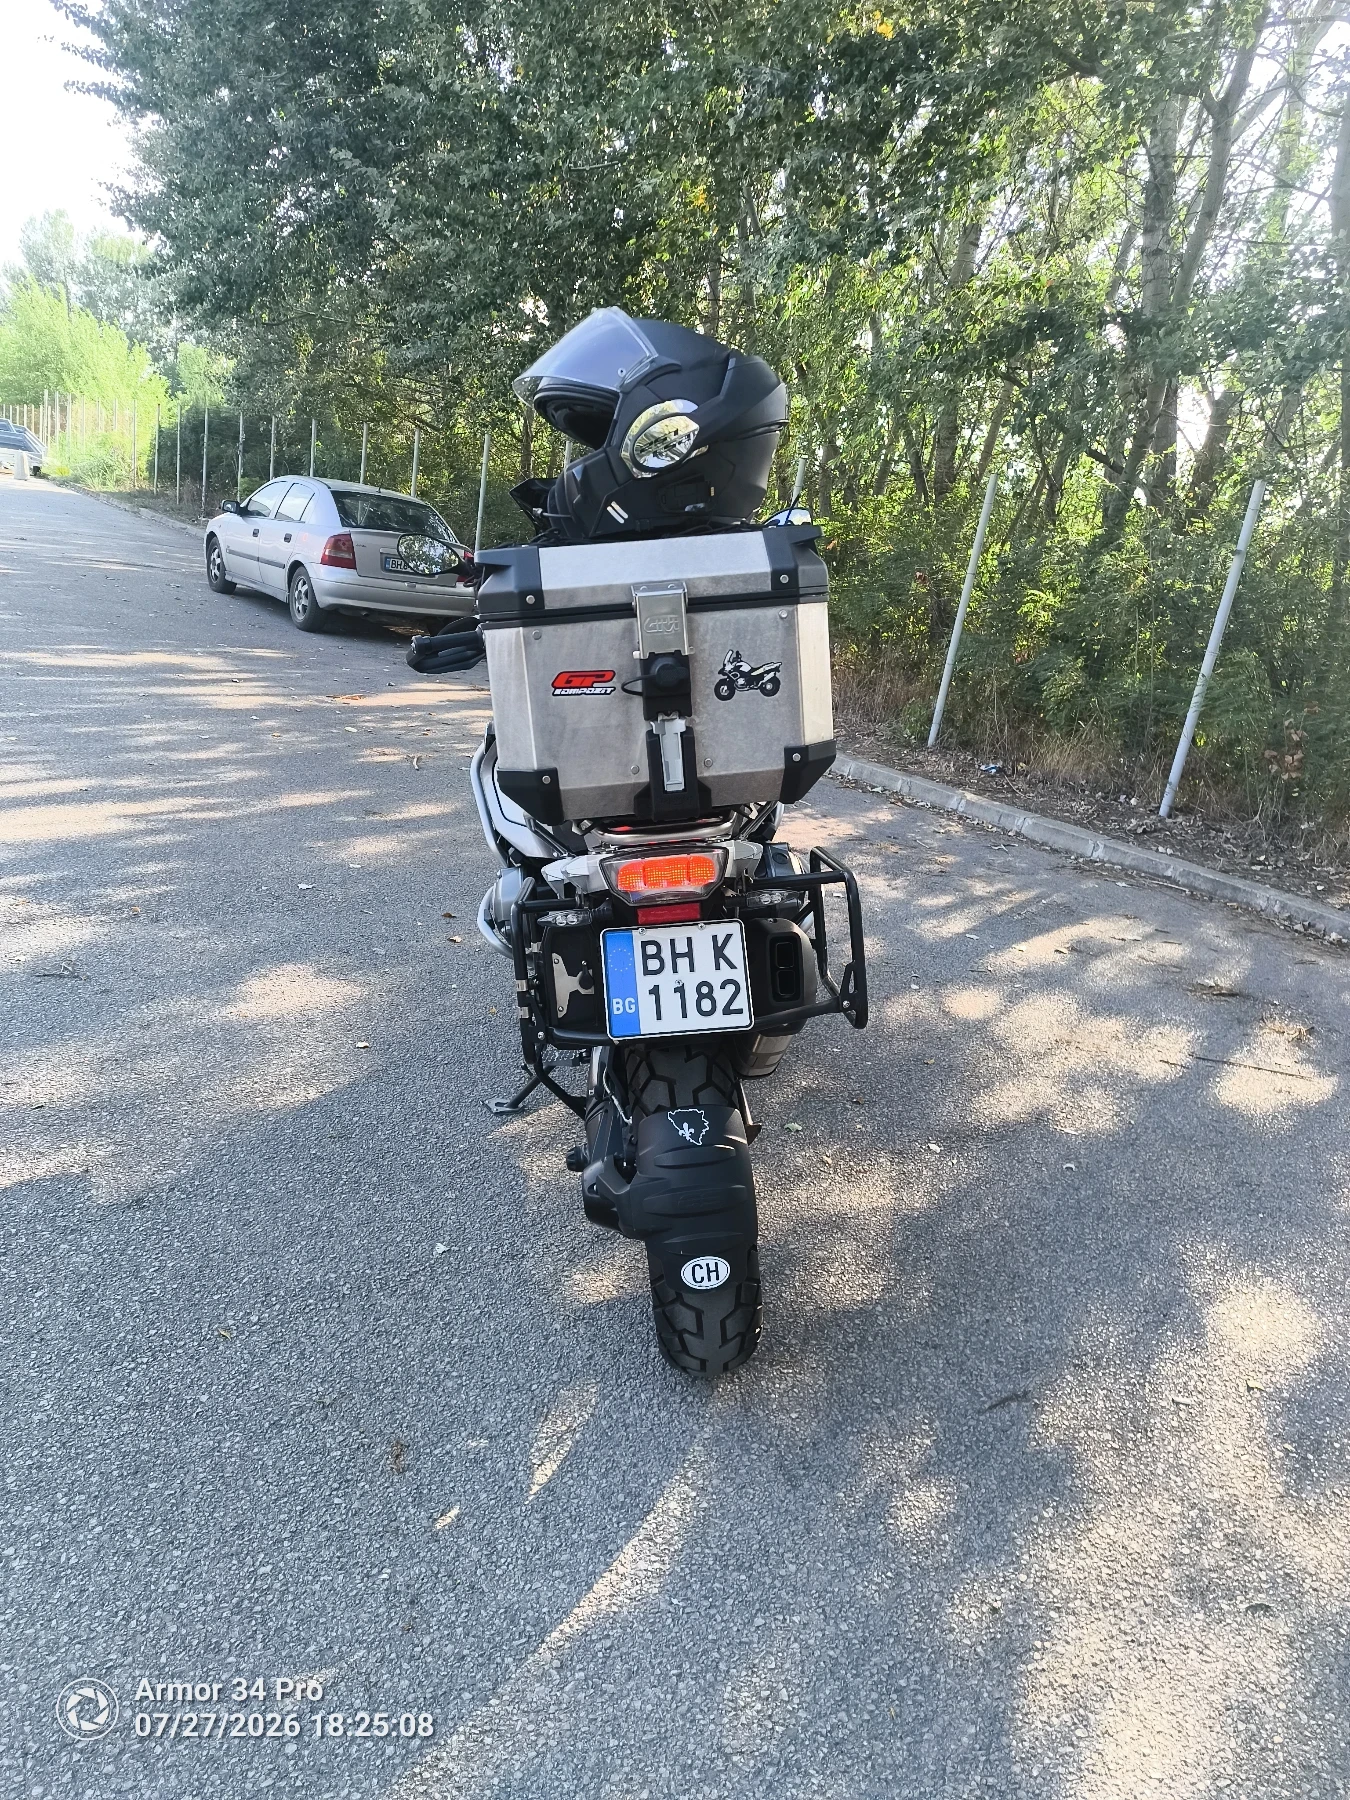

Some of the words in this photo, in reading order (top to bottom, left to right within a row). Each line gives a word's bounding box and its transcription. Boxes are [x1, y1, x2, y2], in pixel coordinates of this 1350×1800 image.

[552, 671, 615, 687] GP
[641, 936, 695, 976] BH
[711, 933, 738, 971] K
[612, 997, 636, 1015] BG
[648, 978, 744, 1021] 1182
[691, 1261, 720, 1284] CH
